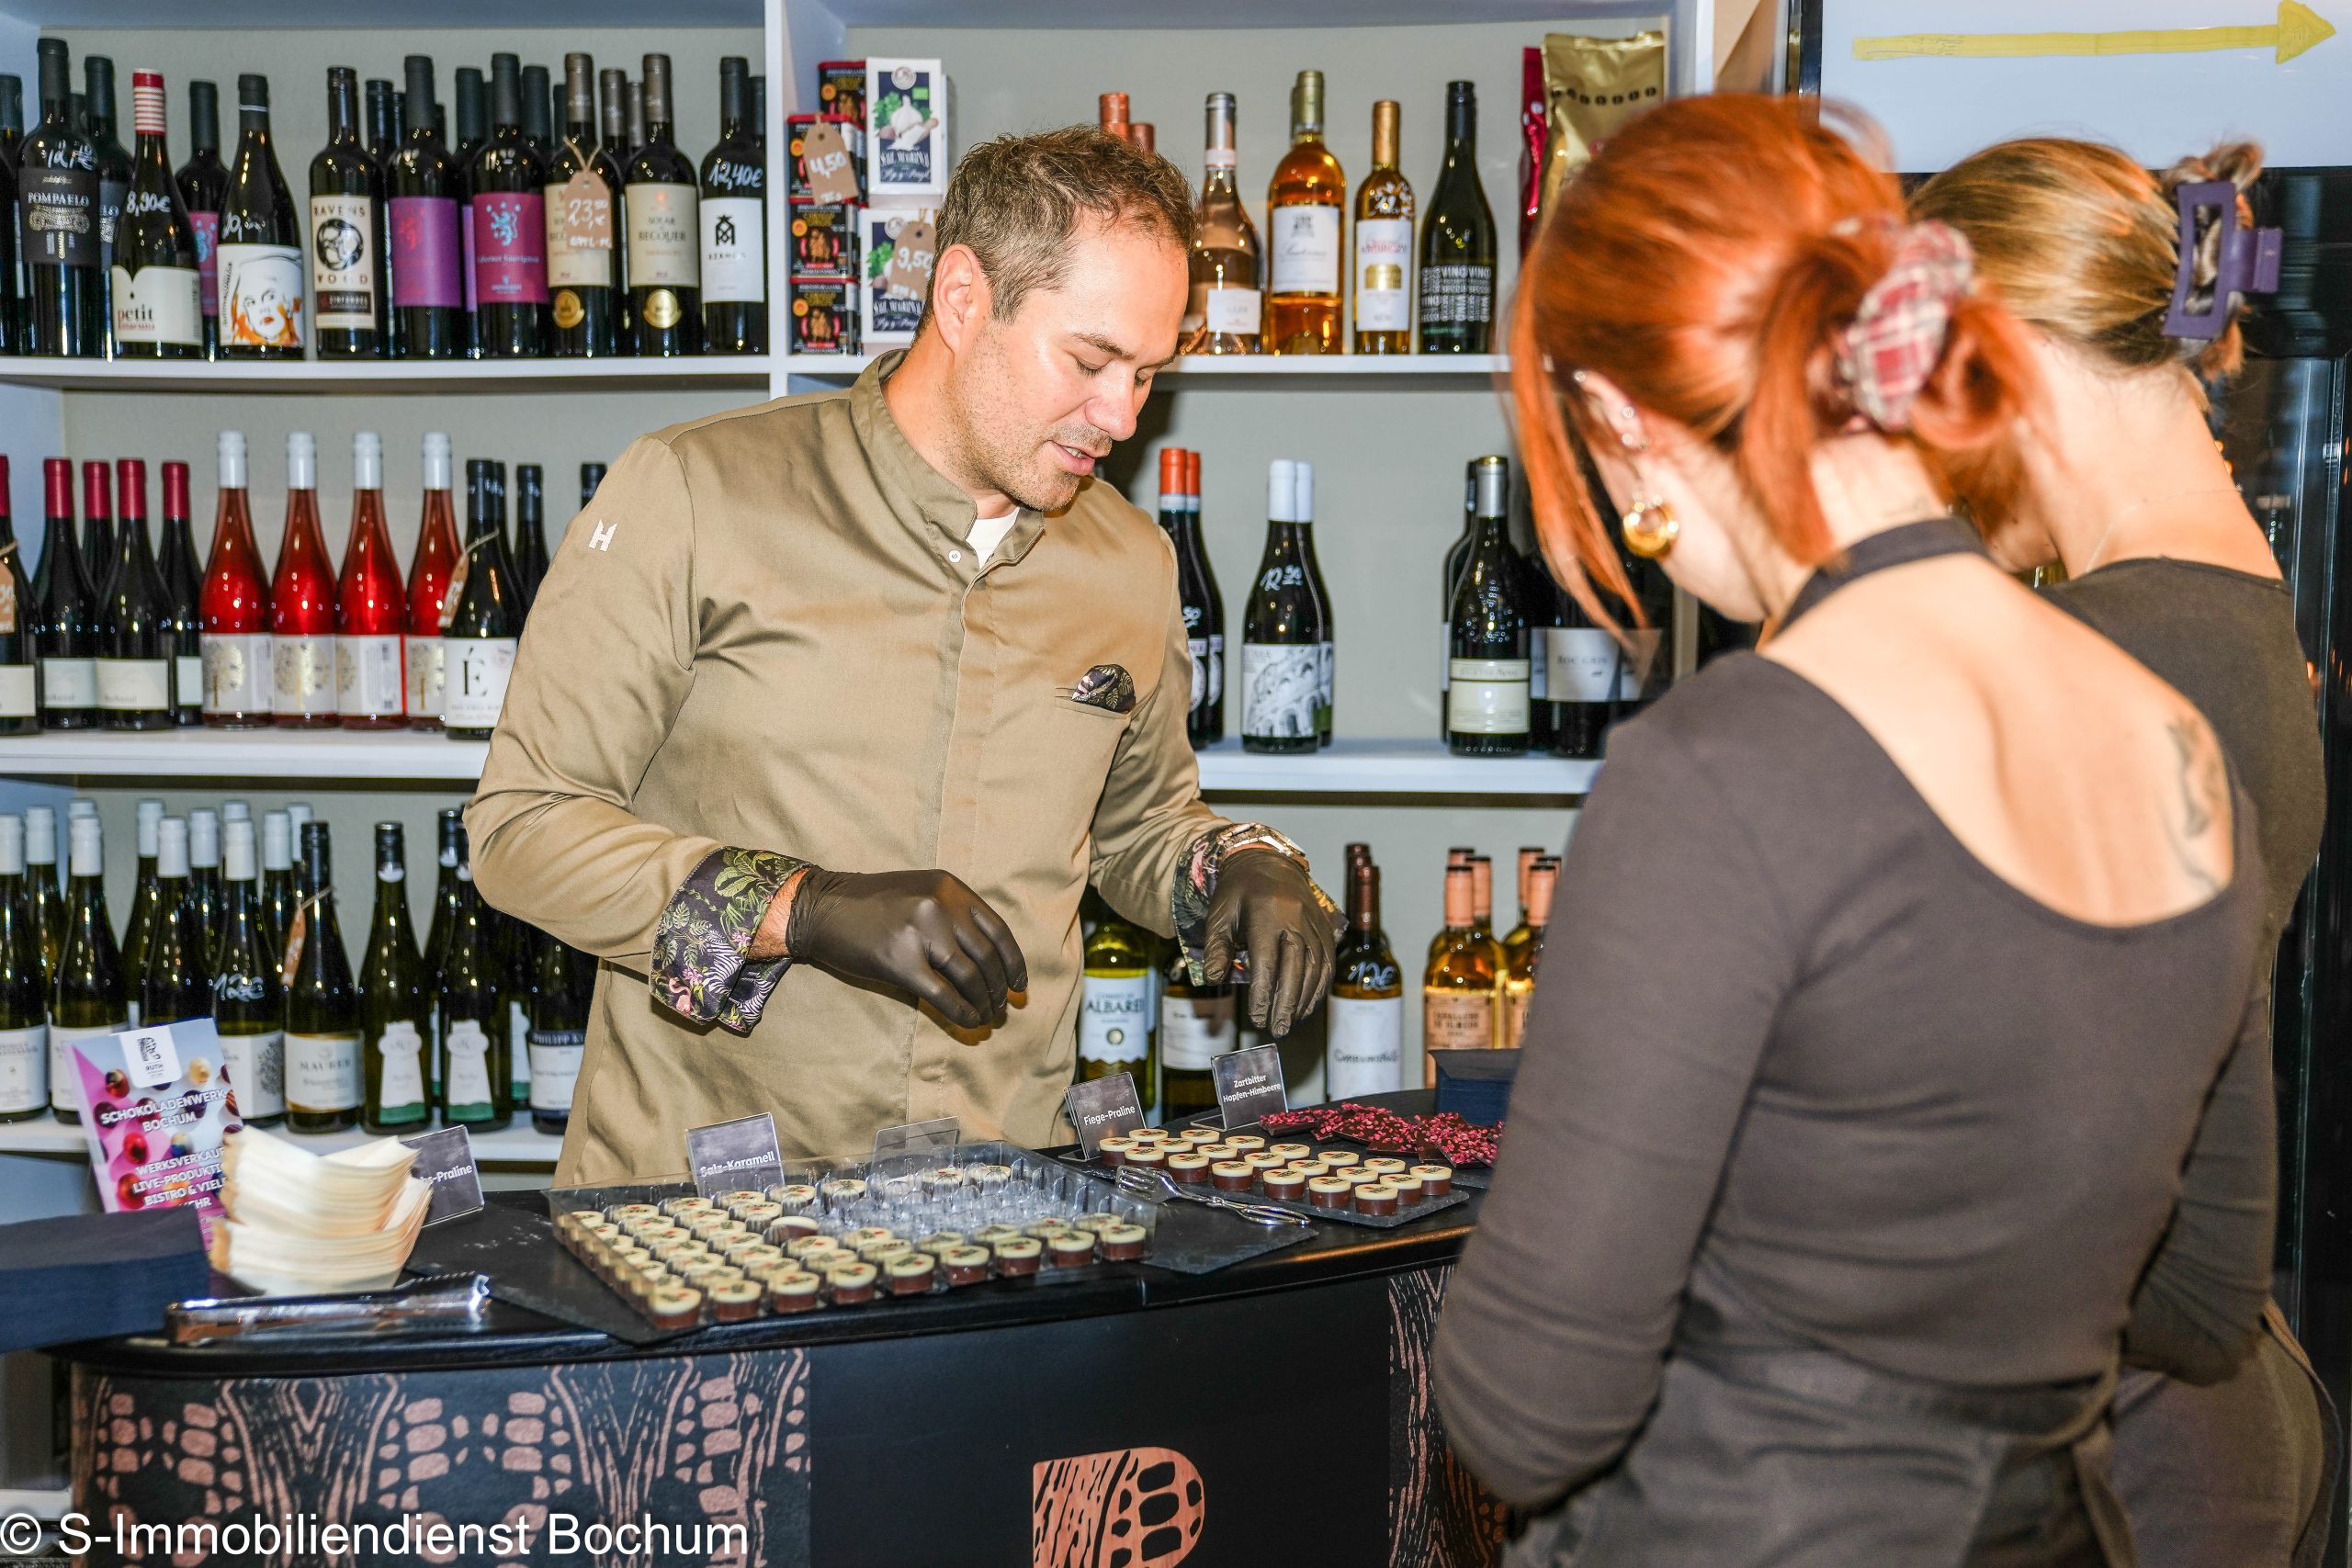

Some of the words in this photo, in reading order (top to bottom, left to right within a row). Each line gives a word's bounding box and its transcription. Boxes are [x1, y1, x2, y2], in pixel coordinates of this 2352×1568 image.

[708, 162, 763, 190] 12,40€
[28, 191, 90, 207] POMPAELO
[126, 190, 172, 217] 8,90€
[118, 304, 154, 321] petit
[1223, 1082, 1282, 1103] Hopfen-Himbeere
[1233, 1074, 1267, 1089] Zartbitter
[100, 1089, 226, 1125] SCHOKOLADENWERK
[1083, 1104, 1136, 1126] Fiege-Praline
[142, 1111, 198, 1133] BOCHUM
[700, 1150, 775, 1178] Salz-Karamell
[144, 1187, 187, 1206] BISTRO
